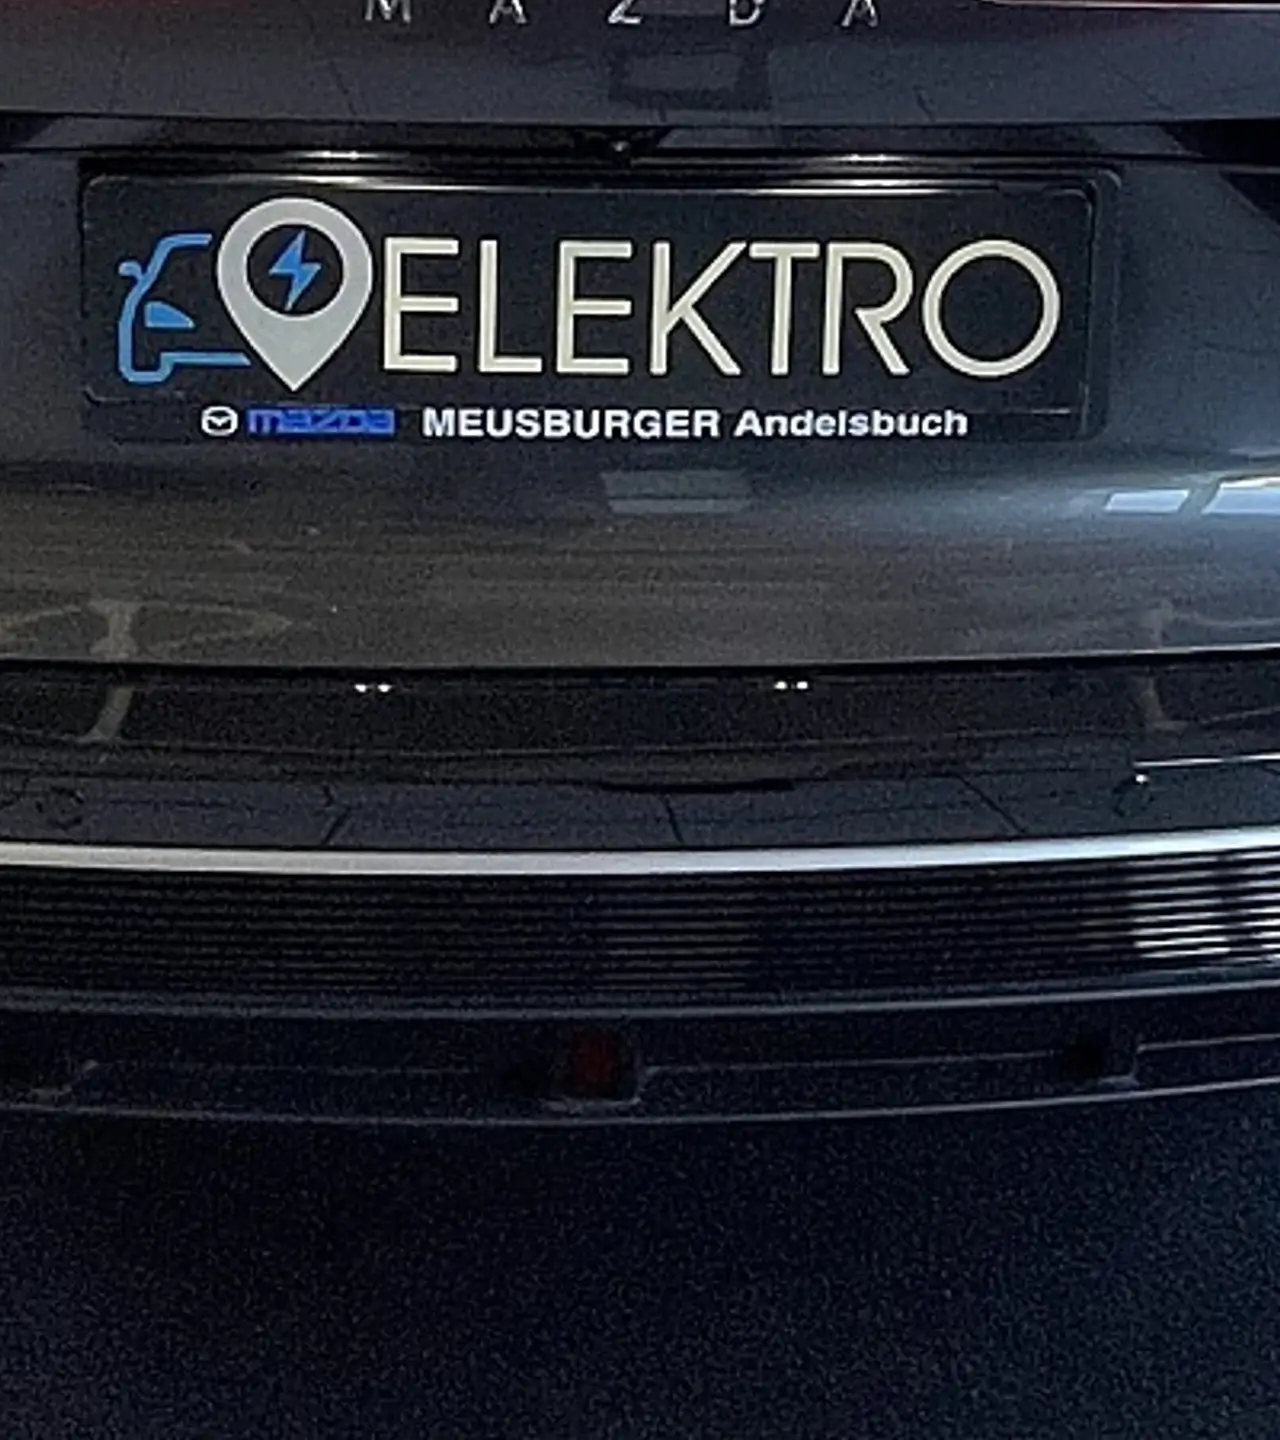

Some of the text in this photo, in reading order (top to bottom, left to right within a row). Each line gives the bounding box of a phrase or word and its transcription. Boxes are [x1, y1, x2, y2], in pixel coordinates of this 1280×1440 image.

[383, 236, 1061, 377] ELEKTRO
[246, 408, 969, 438] mazda MEUSBURGER Andelsbuch
